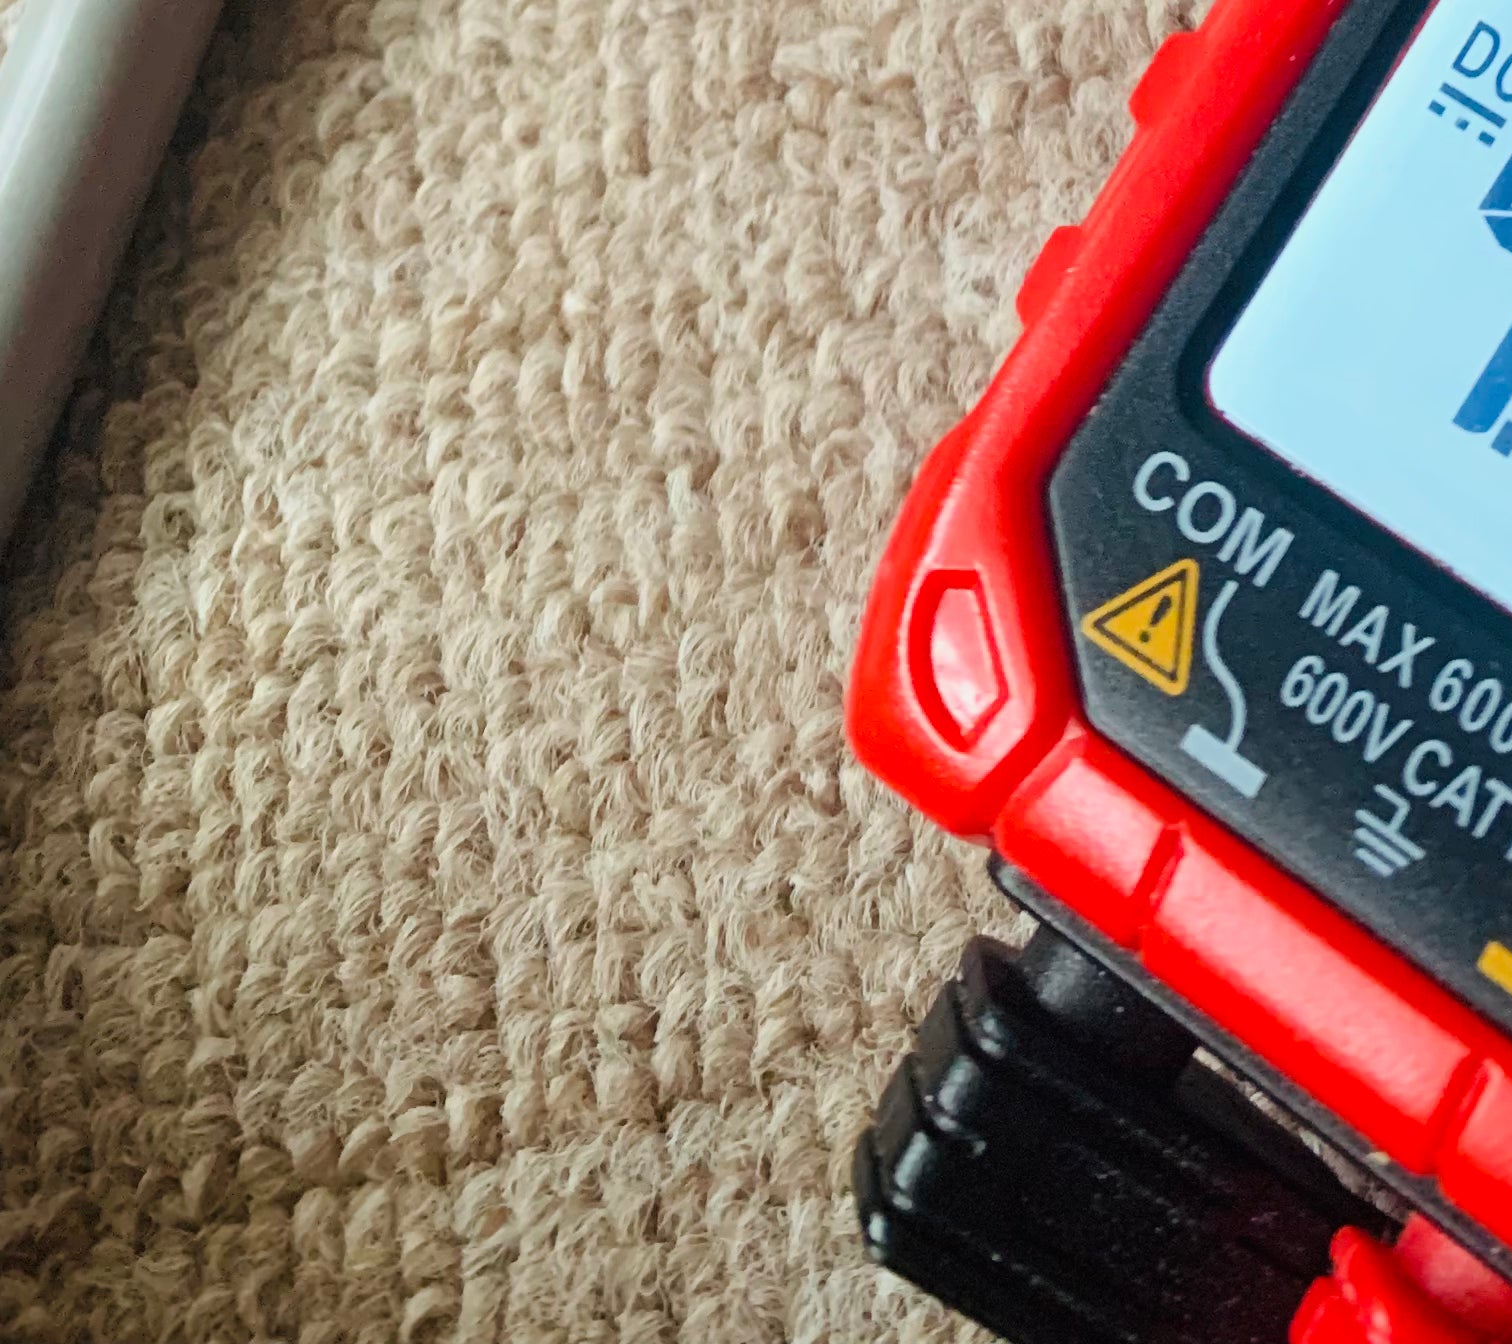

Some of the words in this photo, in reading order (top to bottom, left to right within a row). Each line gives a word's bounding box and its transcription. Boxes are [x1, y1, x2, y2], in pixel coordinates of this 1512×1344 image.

[1132, 451, 1295, 588] COM
[1300, 569, 1436, 689] MAX
[1281, 655, 1411, 764] 600V
